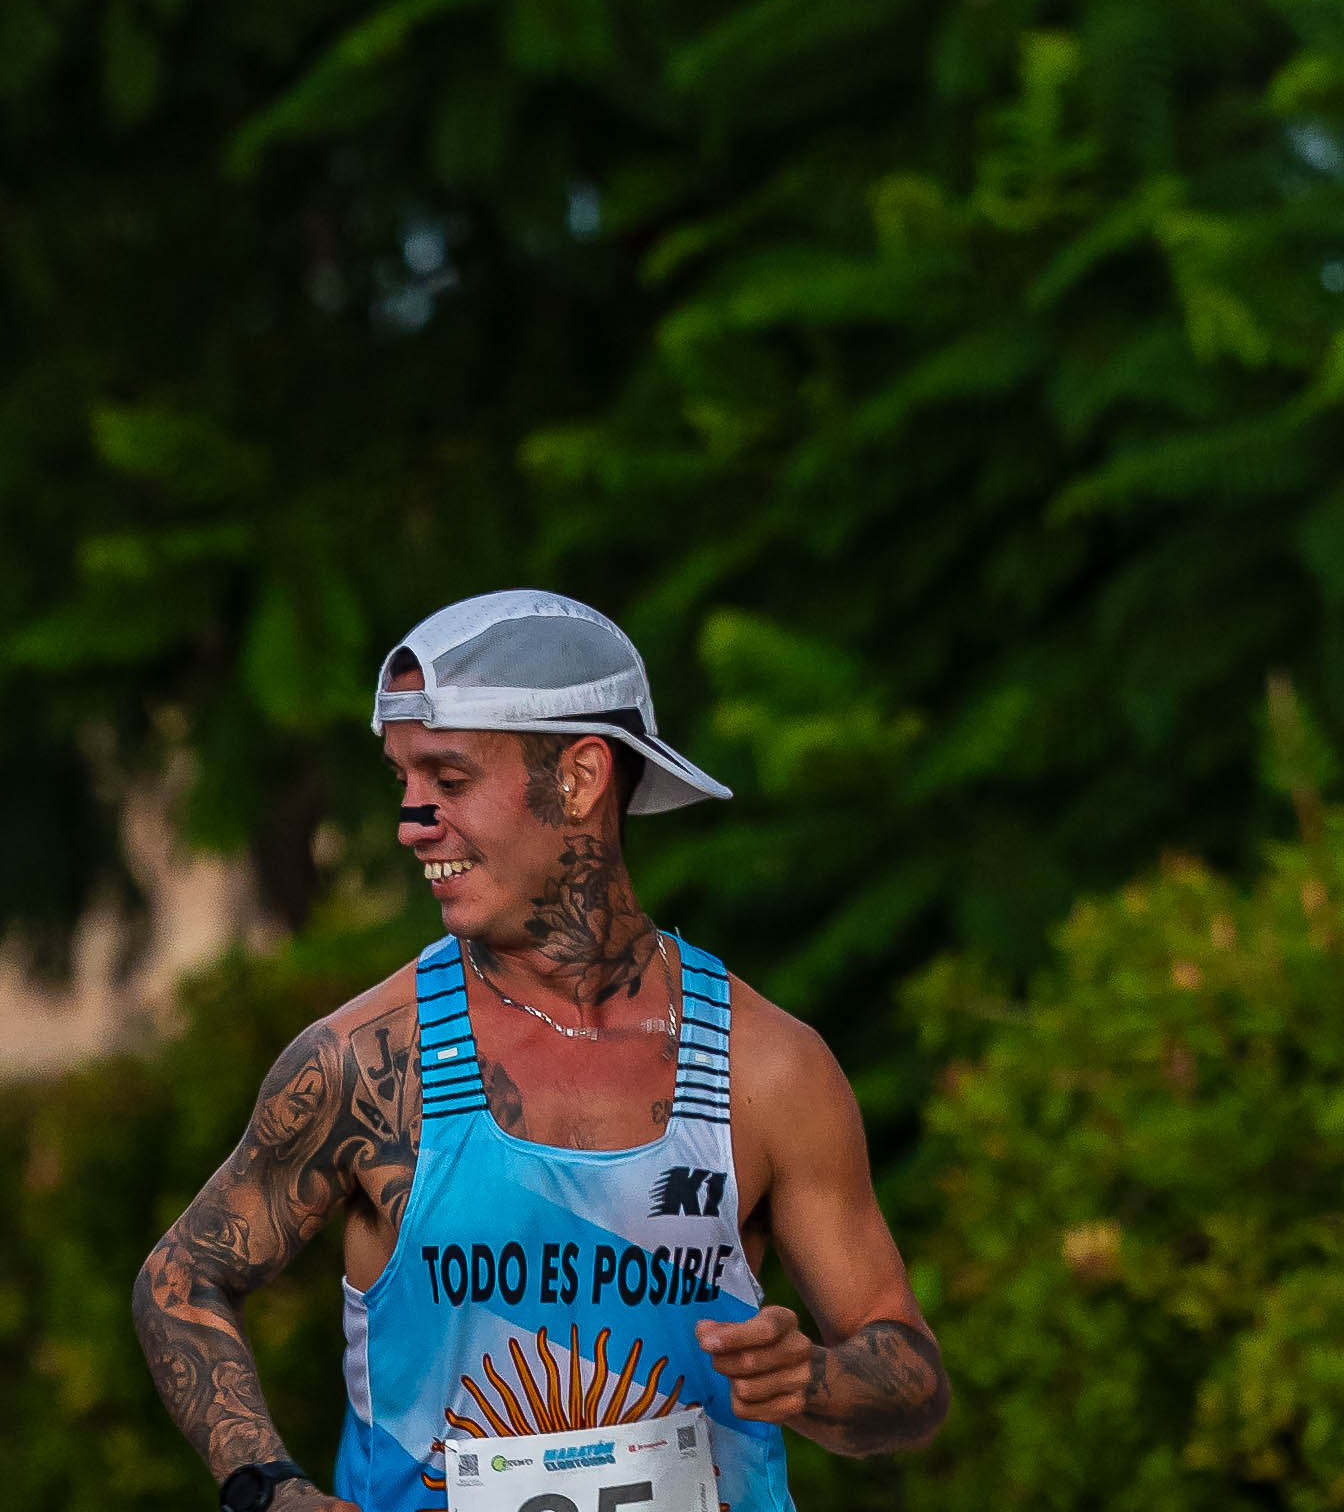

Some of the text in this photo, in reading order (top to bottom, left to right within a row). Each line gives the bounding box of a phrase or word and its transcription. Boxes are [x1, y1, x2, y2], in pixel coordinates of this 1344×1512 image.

[421, 1240, 735, 1308] TODO ES POSIBLE
